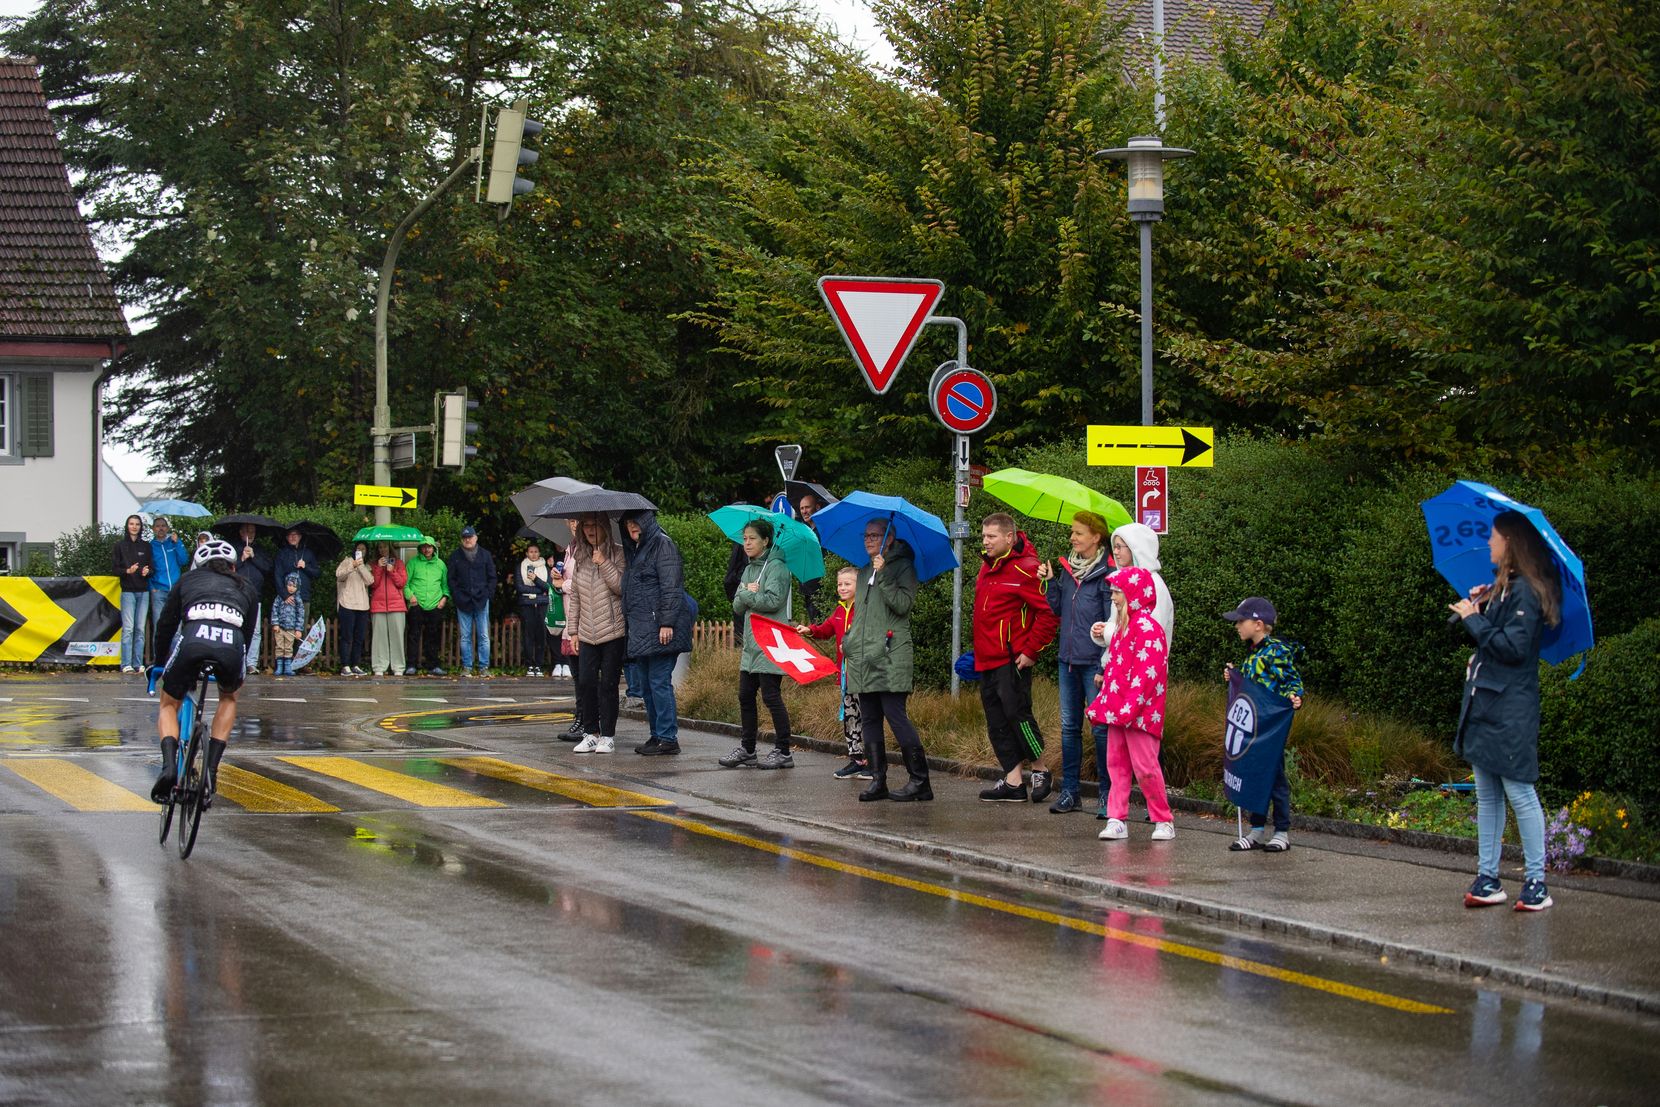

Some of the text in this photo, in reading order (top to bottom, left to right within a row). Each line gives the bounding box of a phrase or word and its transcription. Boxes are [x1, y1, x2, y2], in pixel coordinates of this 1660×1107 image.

[1145, 515, 1160, 526] 72
[195, 624, 234, 644] AFG
[1231, 703, 1250, 726] FCZ
